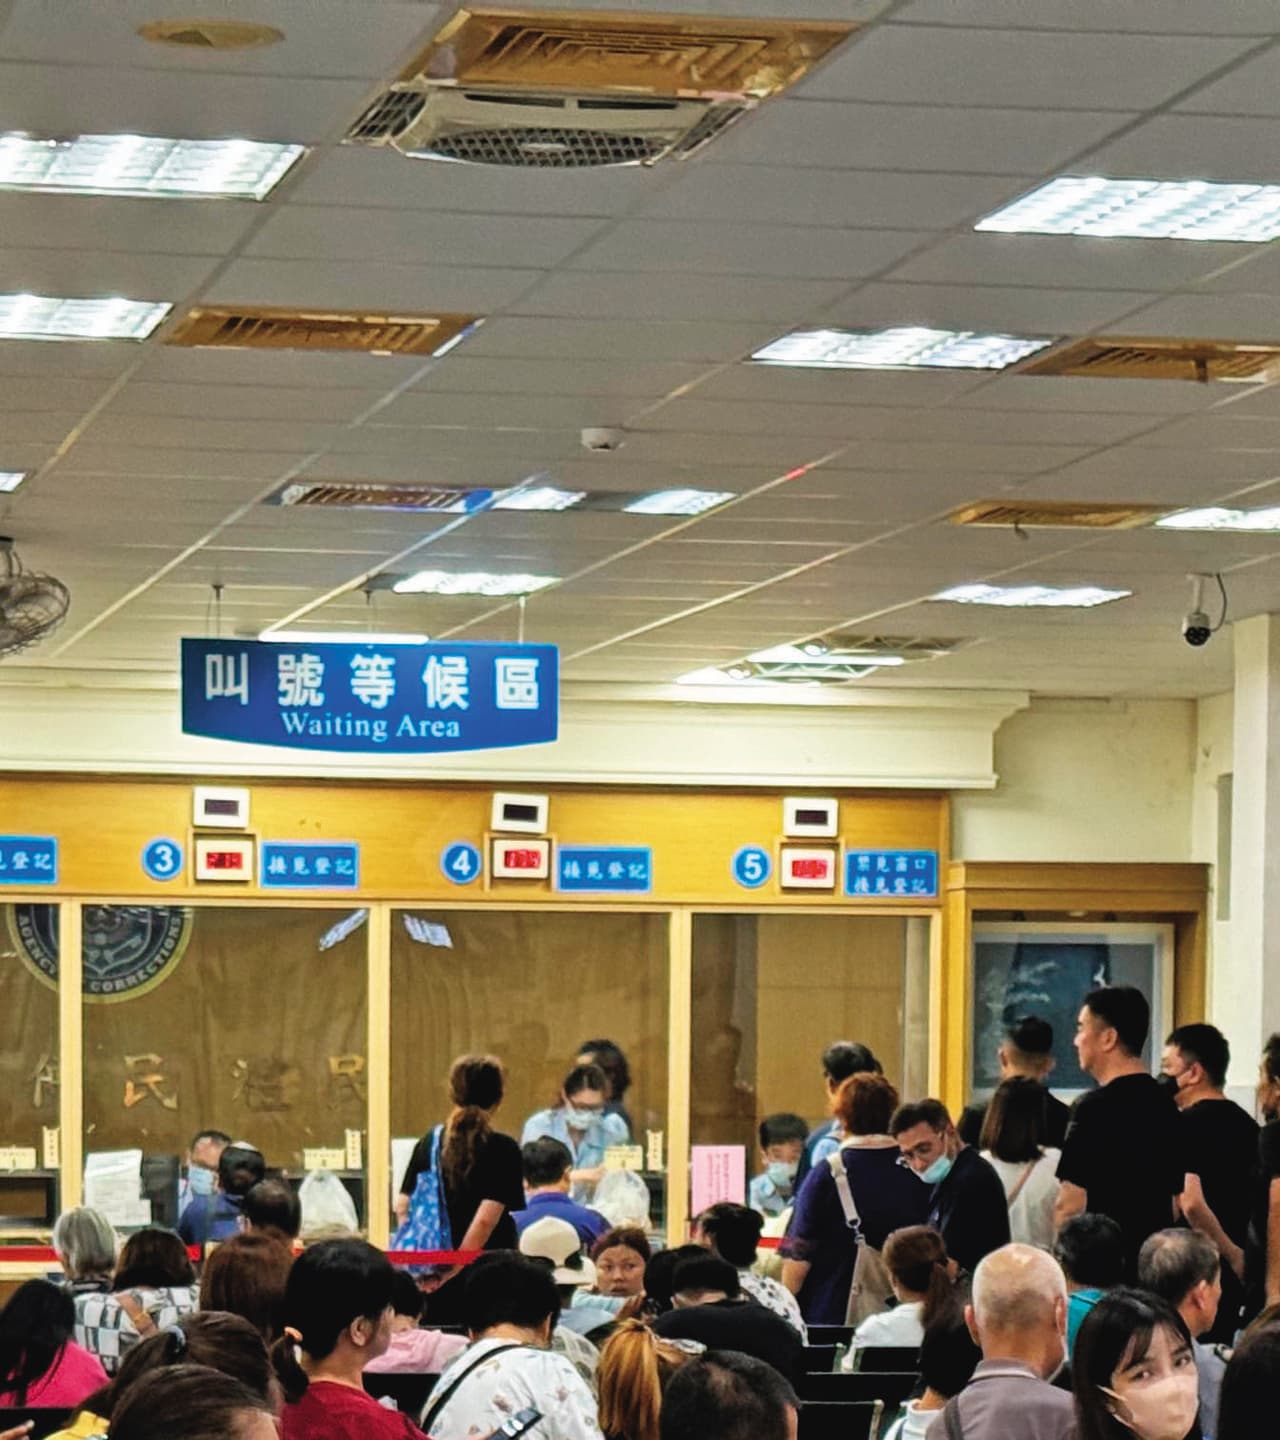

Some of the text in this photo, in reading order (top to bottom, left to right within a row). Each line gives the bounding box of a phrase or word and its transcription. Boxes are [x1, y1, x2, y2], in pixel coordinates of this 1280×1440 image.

[205, 652, 539, 710] 叫號等候區
[281, 712, 461, 741] Waiting Area
[154, 844, 174, 873] 3
[452, 848, 472, 877] 4
[743, 852, 764, 881] 5
[90, 916, 184, 993] CORRECTIONS
